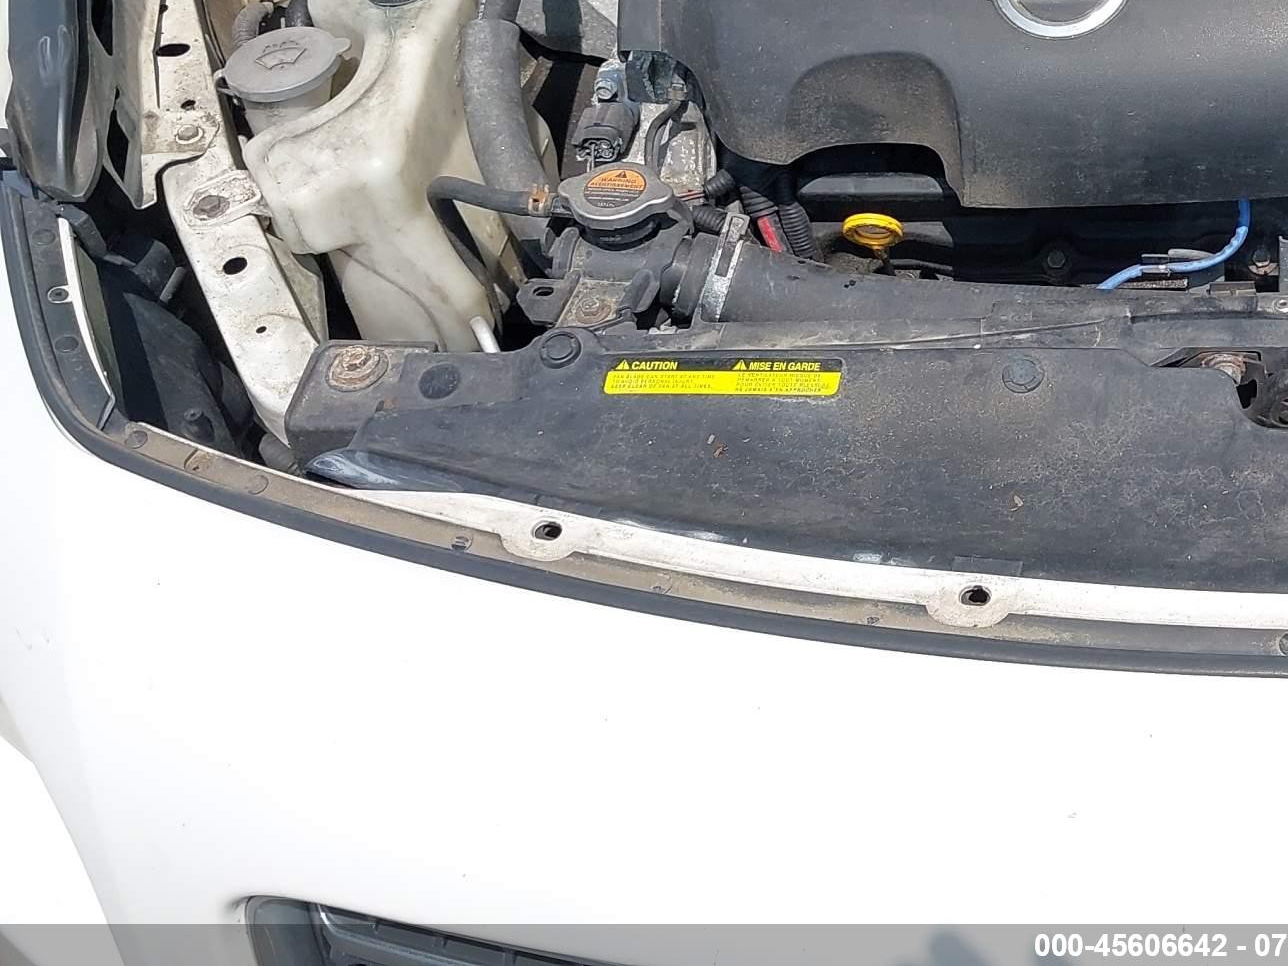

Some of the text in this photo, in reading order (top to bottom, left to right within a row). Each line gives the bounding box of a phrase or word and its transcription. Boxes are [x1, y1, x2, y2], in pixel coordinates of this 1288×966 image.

[631, 361, 678, 371] CAUTION
[748, 361, 821, 371] MISE EN GARDE
